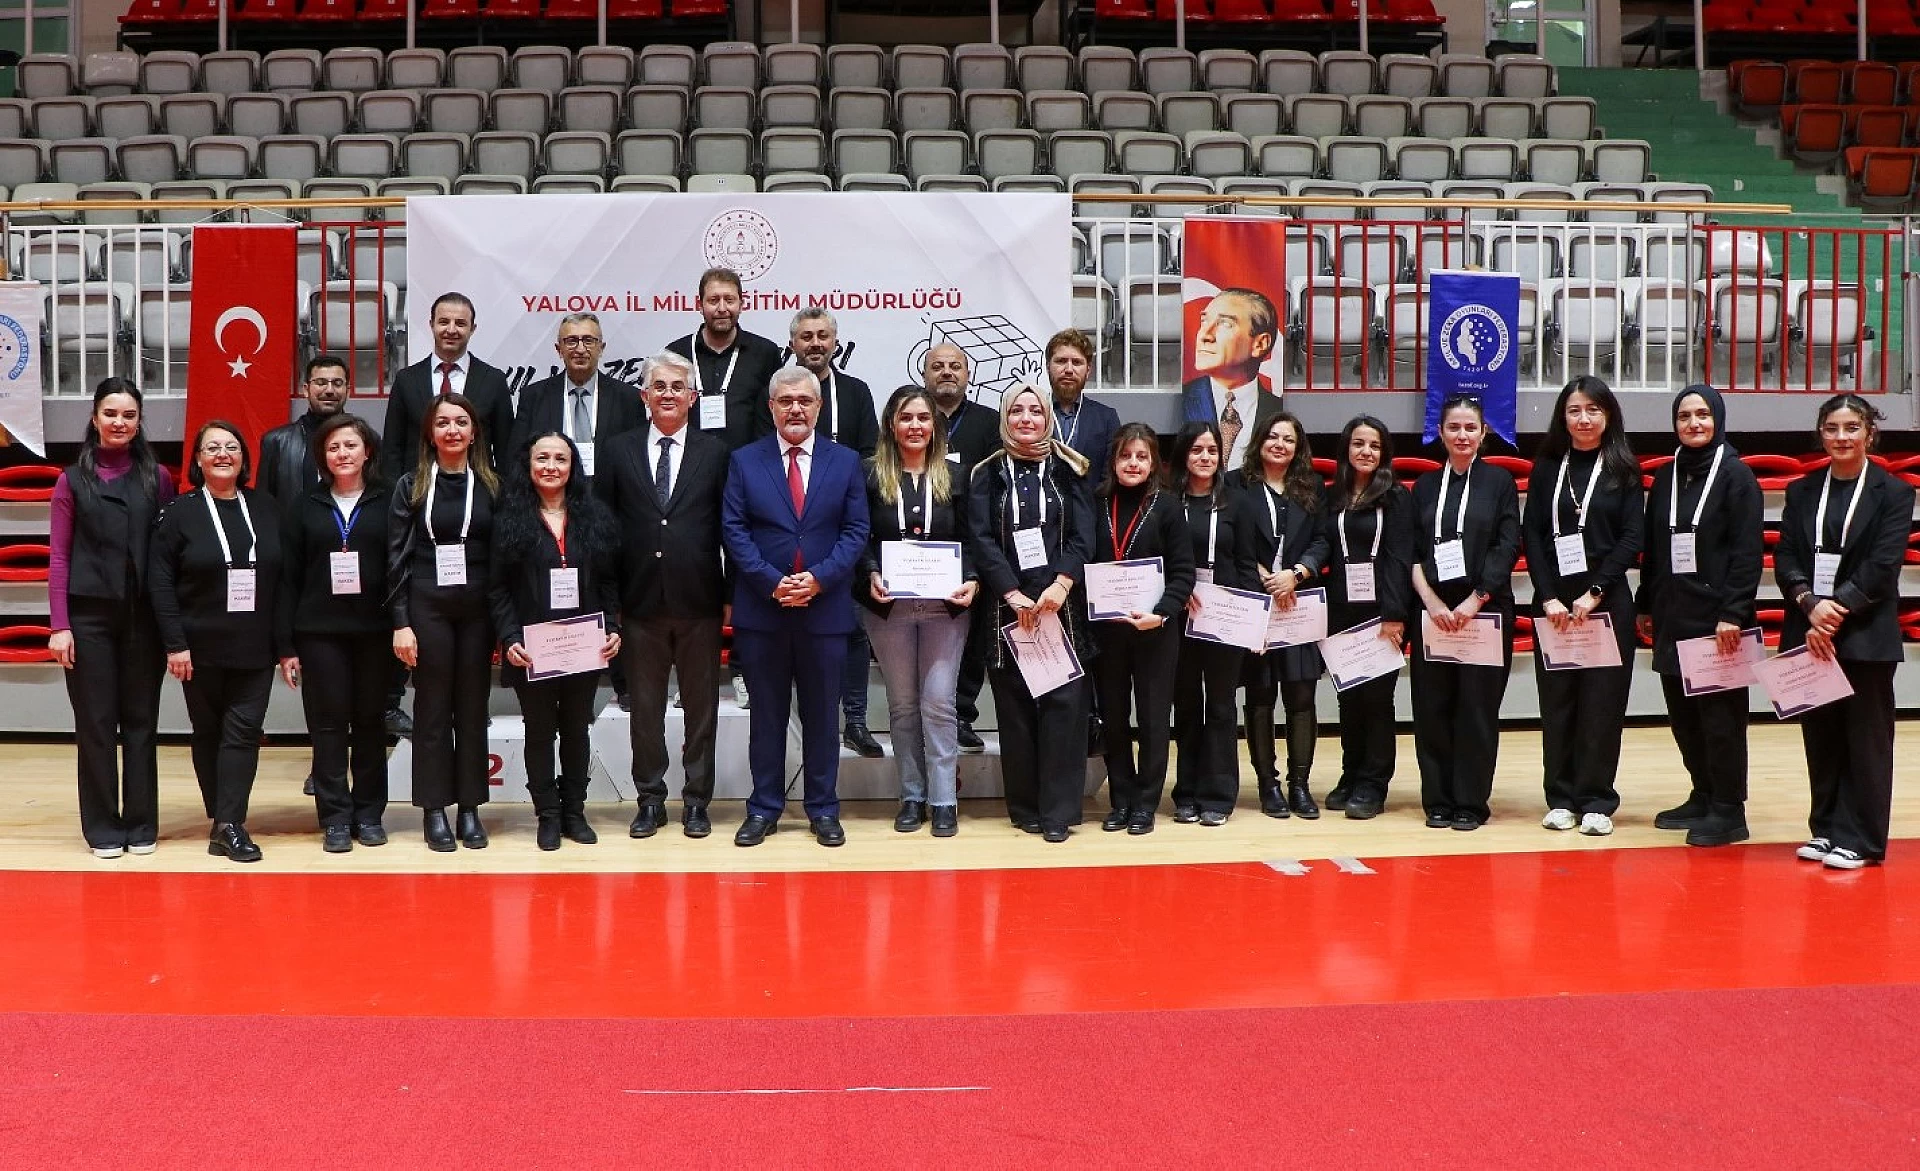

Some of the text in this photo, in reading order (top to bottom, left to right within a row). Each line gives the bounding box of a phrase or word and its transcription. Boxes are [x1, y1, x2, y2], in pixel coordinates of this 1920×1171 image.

[521, 295, 620, 312] YALOVA
[626, 290, 646, 312] İL
[808, 287, 962, 311] MÜDÜRLÜĞÜ
[487, 753, 504, 786] 2
